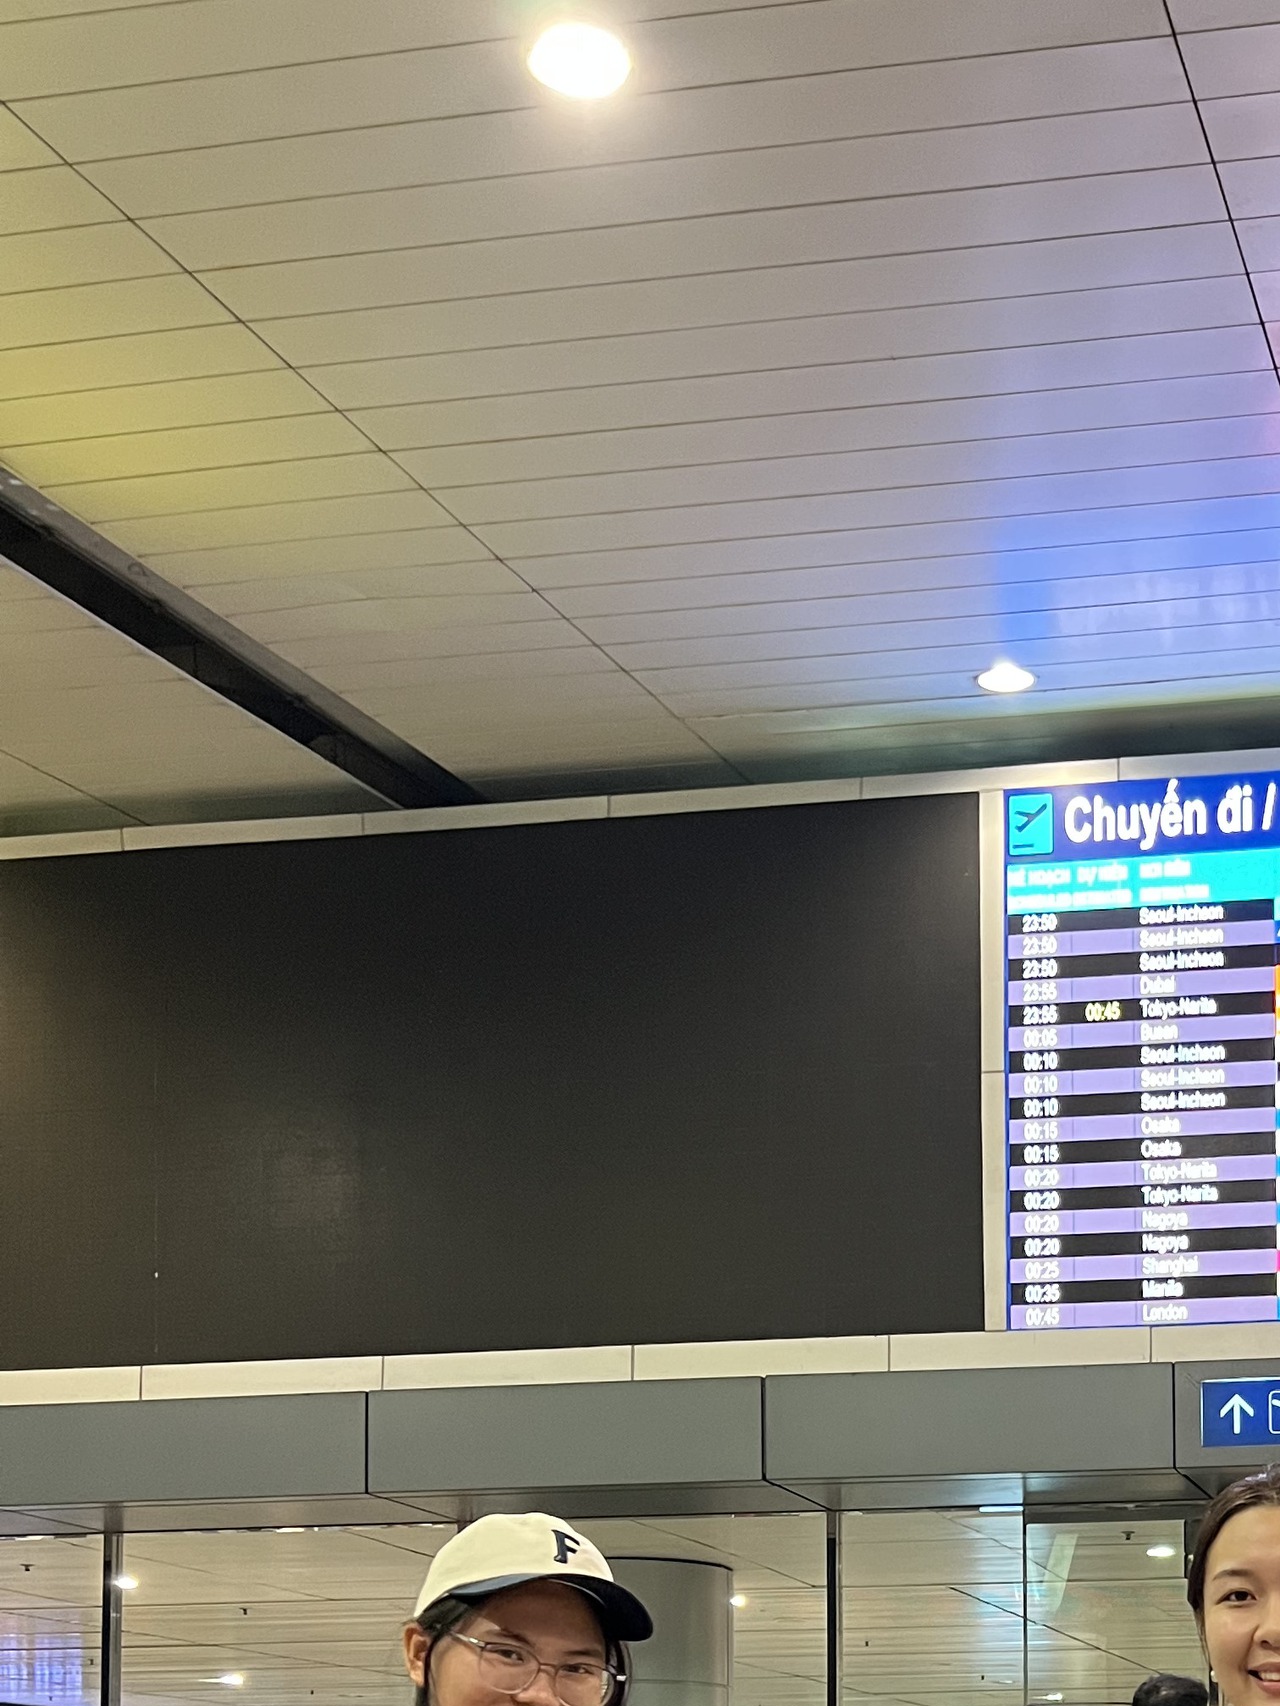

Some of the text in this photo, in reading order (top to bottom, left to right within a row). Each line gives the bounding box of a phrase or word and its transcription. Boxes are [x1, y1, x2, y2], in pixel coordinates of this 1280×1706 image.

[1064, 780, 1209, 851] Chuyến
[1217, 793, 1254, 835] đi
[1261, 783, 1275, 830] /
[1139, 905, 1224, 925] Seoul-Incheon
[1139, 928, 1224, 948] Seoul-Incheon
[1139, 951, 1225, 971] Seoul-Incheon
[1085, 1002, 1121, 1021] 00:45
[1140, 997, 1217, 1020] Tokyo-Narita
[1024, 1029, 1058, 1048] 00:05
[1140, 1023, 1178, 1042] Busan
[1024, 1052, 1058, 1071] 00:10
[1140, 1045, 1225, 1065] Seoul-Incheon
[1024, 1076, 1058, 1095] 00:10
[1140, 1068, 1225, 1088] Seoul-Incheon
[1024, 1099, 1058, 1118] 00:10
[1140, 1091, 1226, 1111] Seoul-Incheon
[1025, 1122, 1058, 1141] 00:15
[1141, 1116, 1181, 1134] Osaka
[1025, 1145, 1058, 1164] 00:15
[1141, 1139, 1182, 1158] Osaka
[1025, 1168, 1058, 1187] 00:20
[1141, 1161, 1217, 1183] Tokyo-Narita
[1025, 1191, 1058, 1210] 00:20
[1141, 1184, 1218, 1207] Tokyo-Narita
[1025, 1214, 1059, 1233] 00:20
[1142, 1210, 1188, 1231] Nagoya
[1025, 1238, 1059, 1257] 00:20
[1142, 1234, 1189, 1253] Nagoya
[1026, 1261, 1059, 1280] 00:25
[1142, 1256, 1198, 1277] Shanghai
[1026, 1284, 1059, 1303] 00:35
[1026, 1307, 1059, 1326] 00:45
[1143, 1303, 1188, 1321] London
[554, 1528, 581, 1565] F
